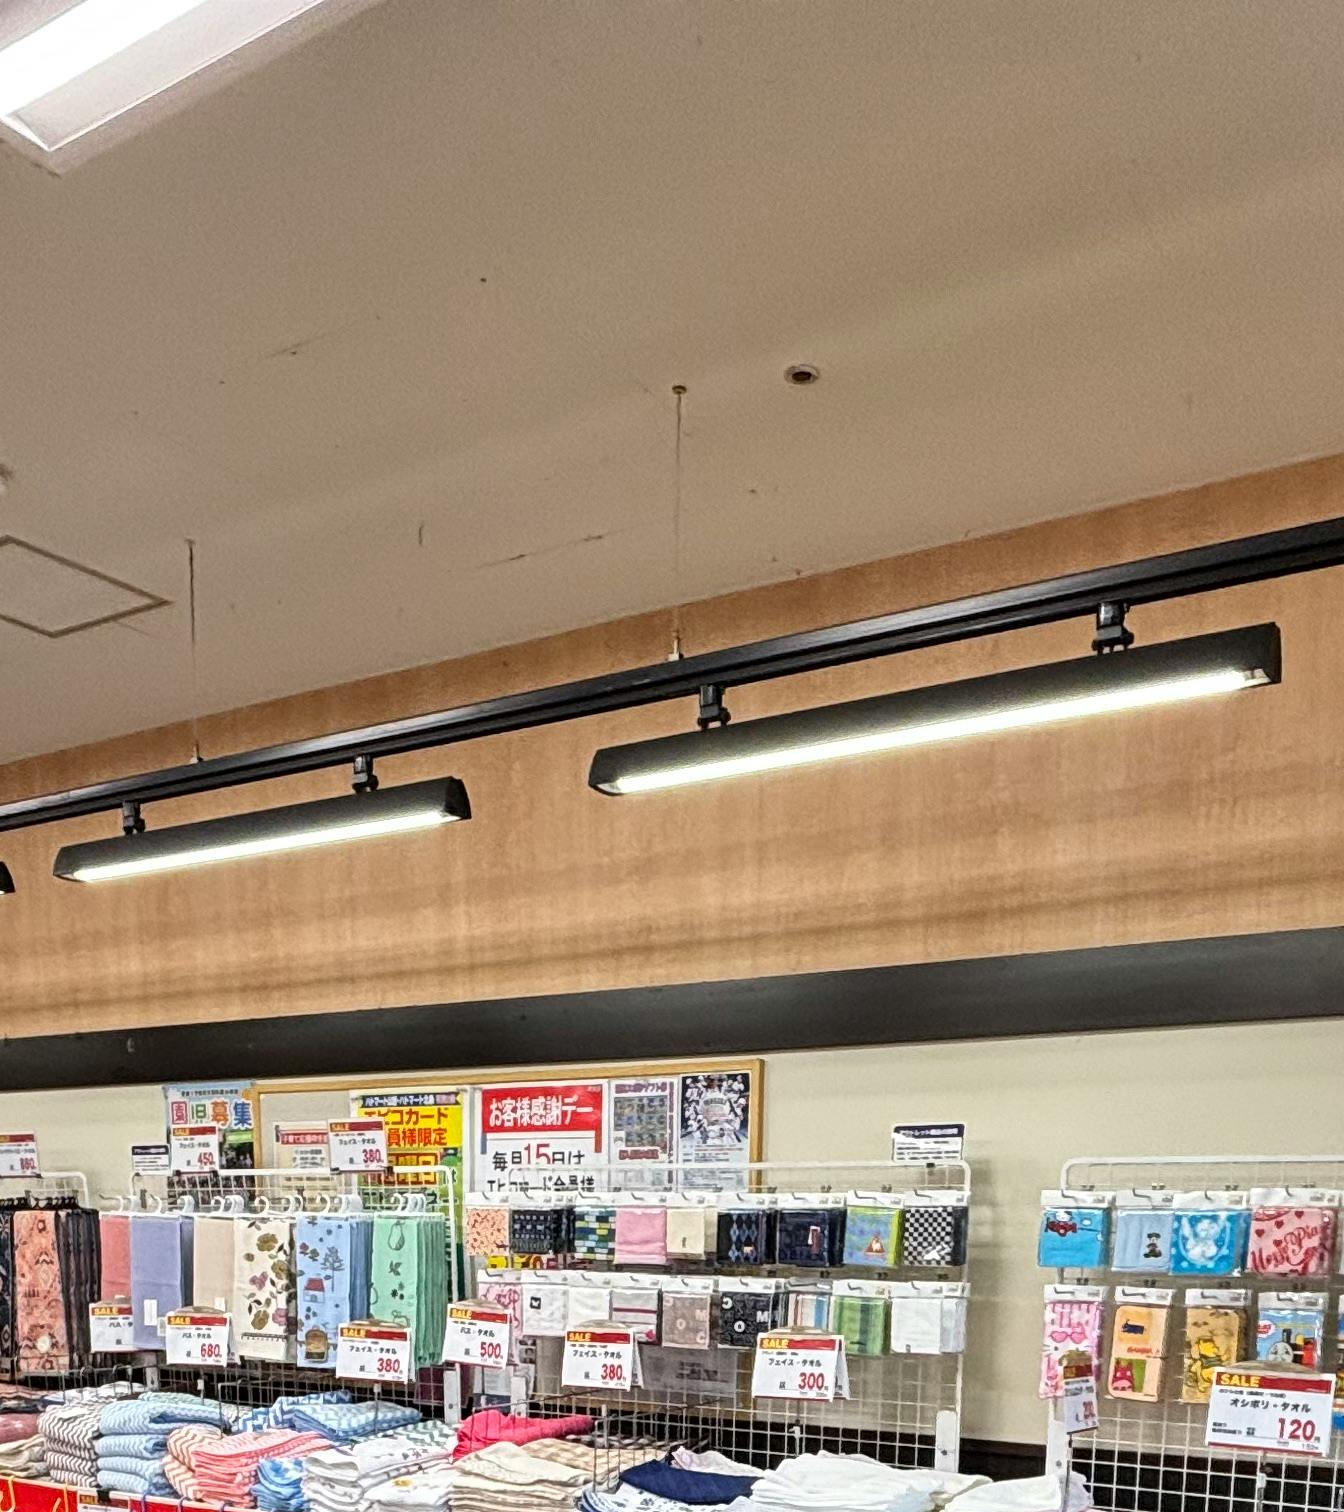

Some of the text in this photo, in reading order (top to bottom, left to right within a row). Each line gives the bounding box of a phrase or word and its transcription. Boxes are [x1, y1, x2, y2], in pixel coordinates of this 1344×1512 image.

[489, 1094, 594, 1127] お客様感謝デー
[387, 1127, 447, 1147] 員様限定
[568, 1332, 592, 1341] SALE
[762, 1338, 789, 1348] SALE
[200, 1343, 220, 1357] 680
[480, 1342, 502, 1359] 500
[377, 1358, 400, 1373] 380
[601, 1363, 623, 1380] 380
[798, 1372, 825, 1390] 300
[1220, 1374, 1261, 1388] SALE
[1230, 1398, 1311, 1413] オシボリ・タオル
